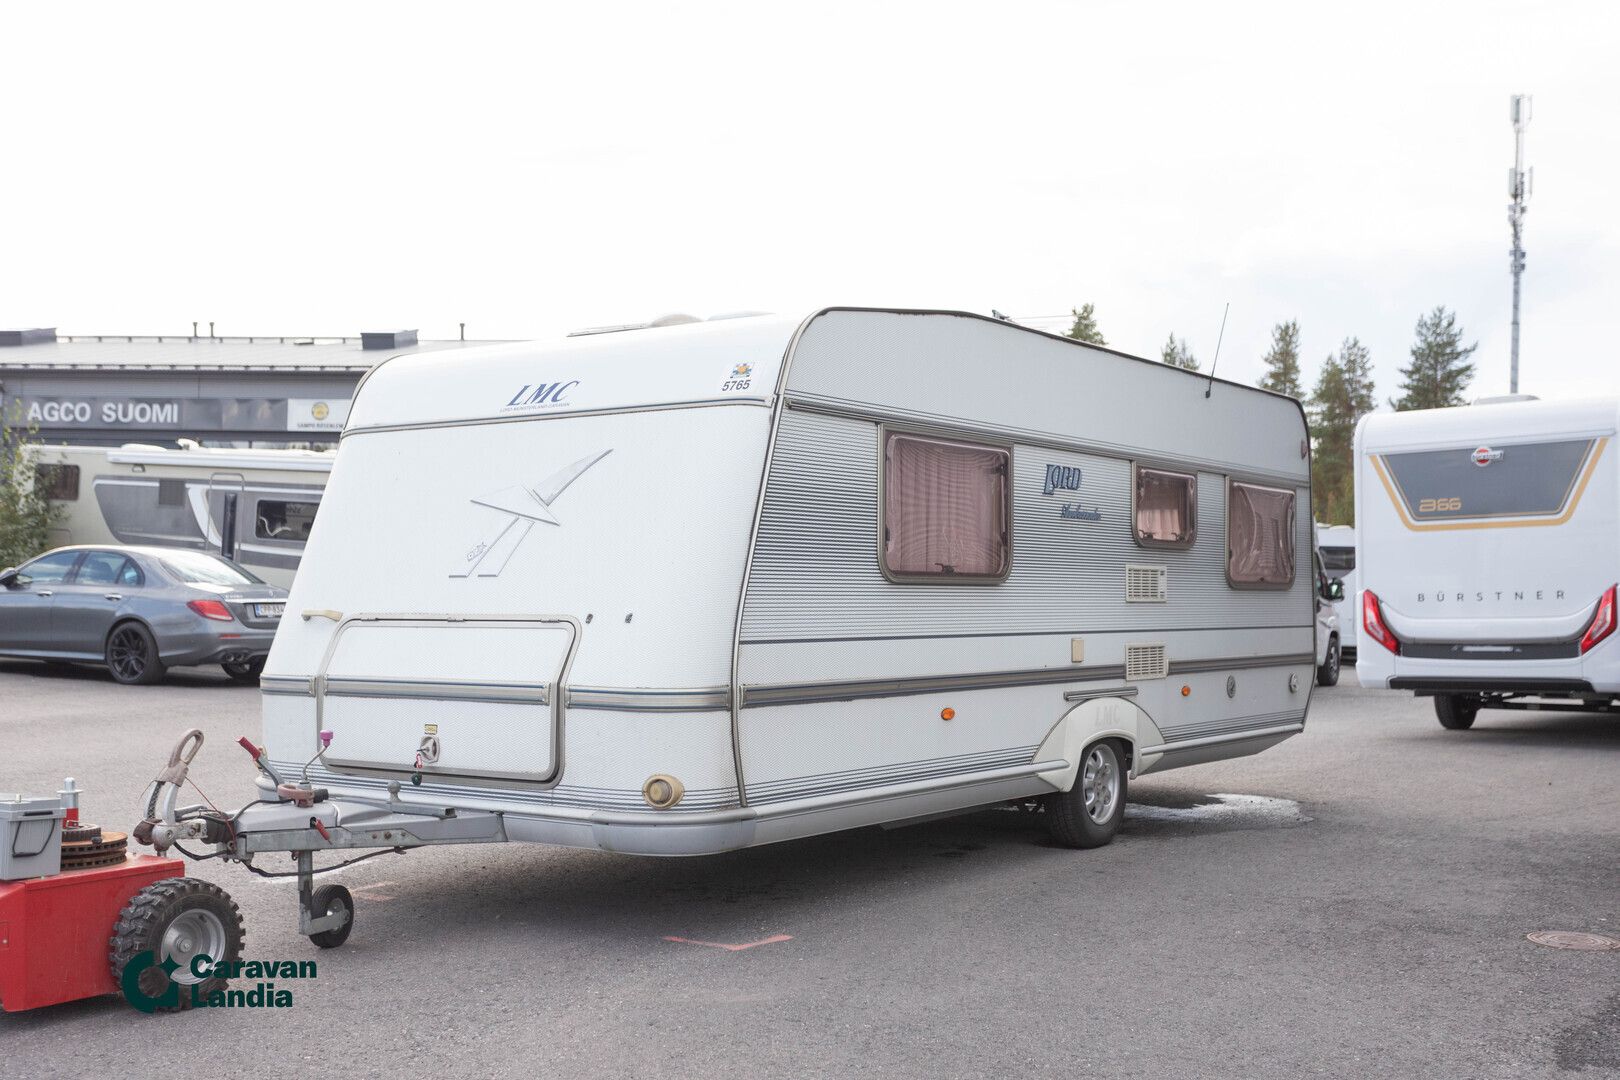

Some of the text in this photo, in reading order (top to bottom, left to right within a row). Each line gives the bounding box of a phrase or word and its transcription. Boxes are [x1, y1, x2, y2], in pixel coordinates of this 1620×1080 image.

[506, 380, 581, 406] LMC
[721, 379, 752, 391] 5765
[27, 401, 178, 423] AGCO SUOMI
[1417, 590, 1564, 602] BÜRSTNER
